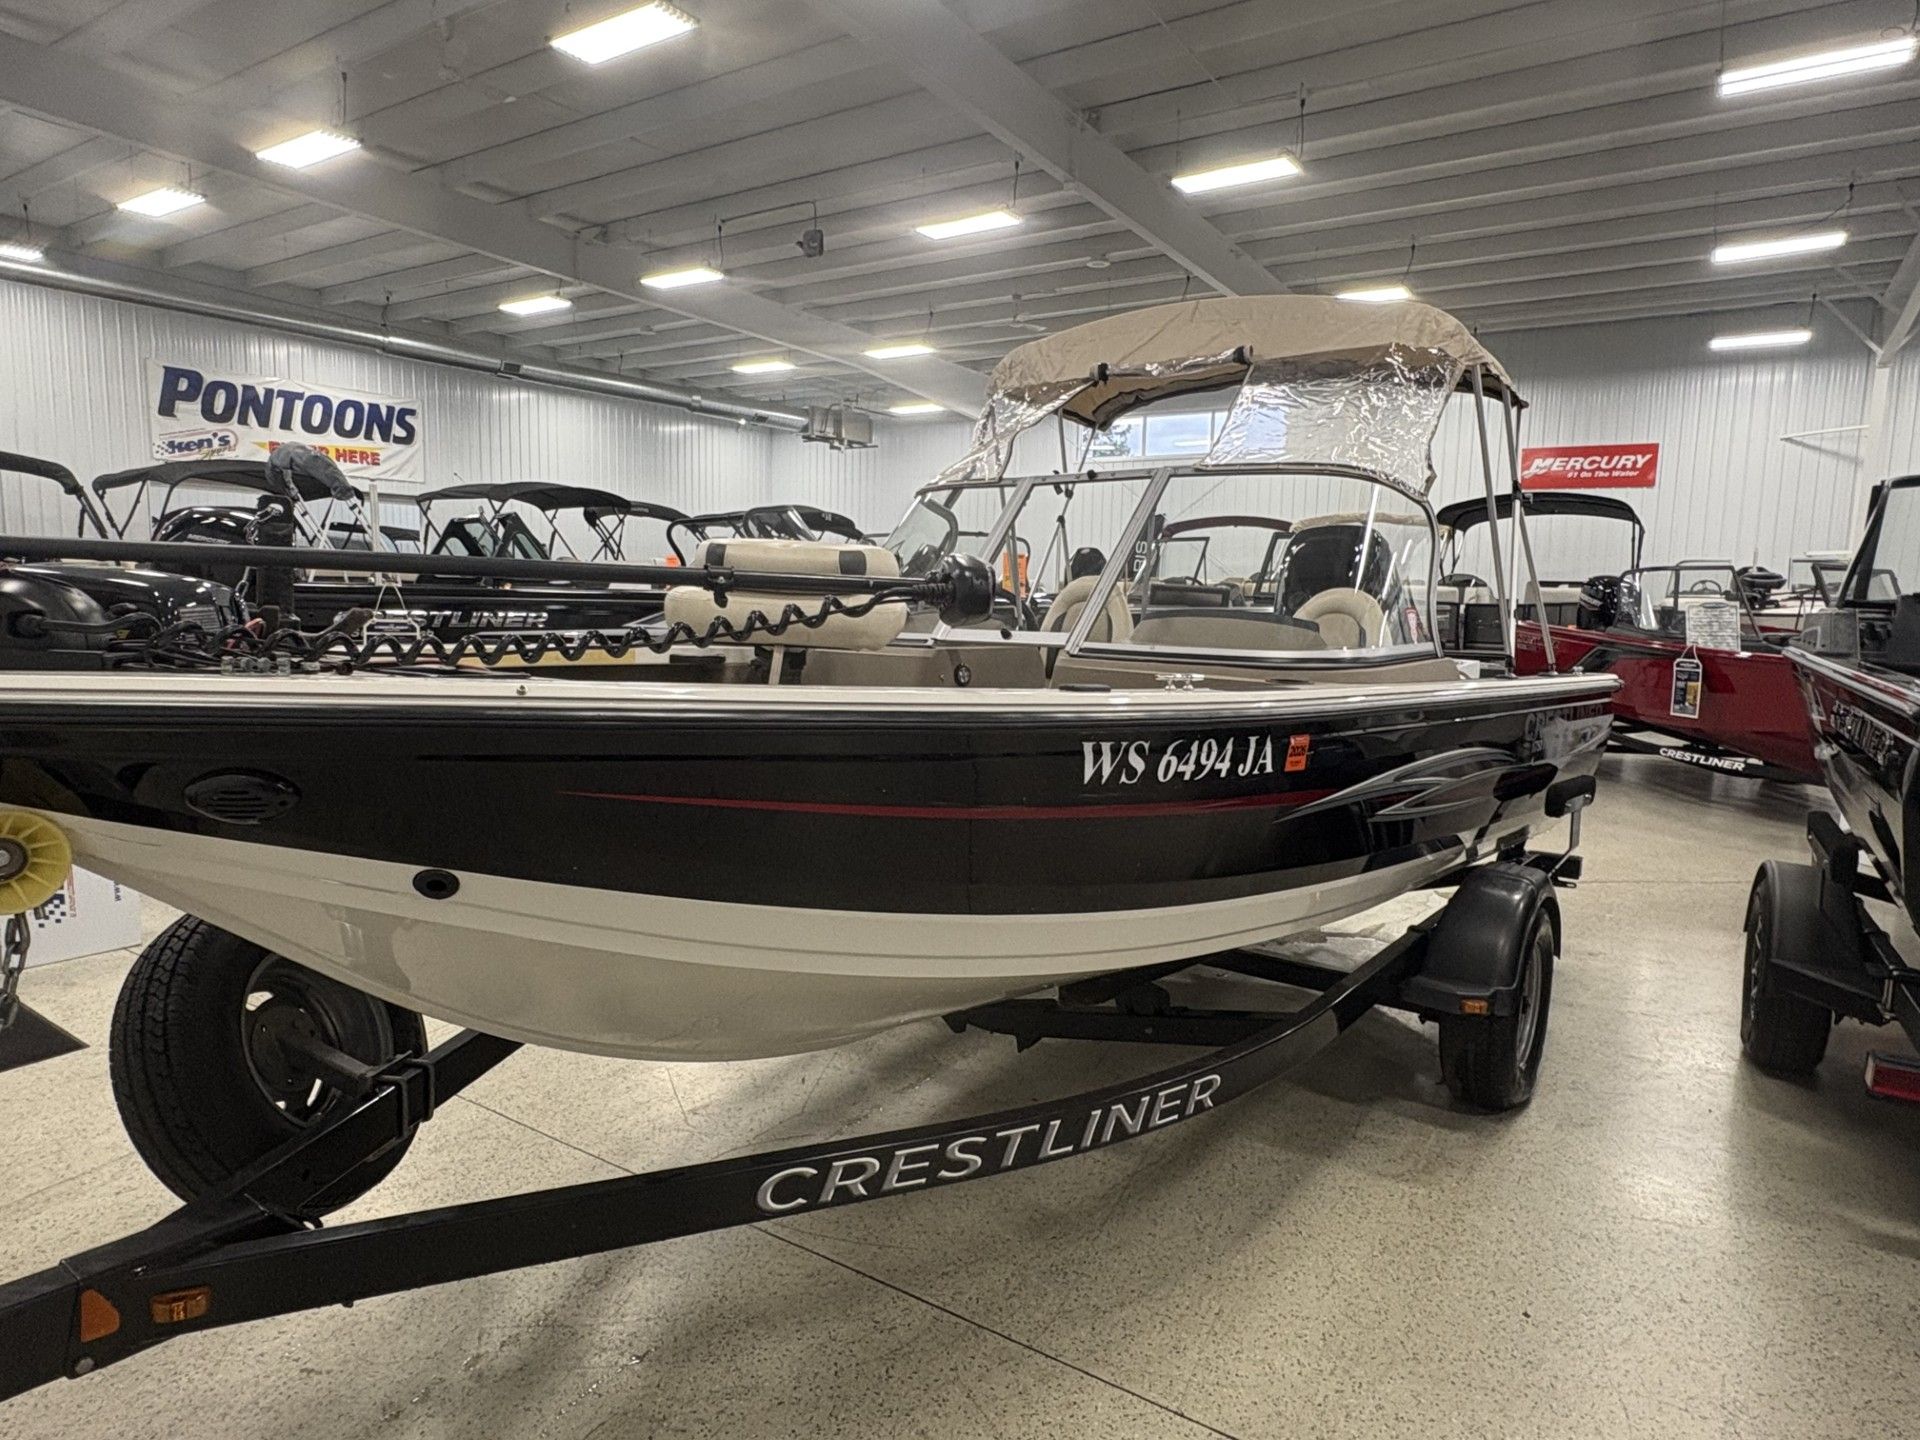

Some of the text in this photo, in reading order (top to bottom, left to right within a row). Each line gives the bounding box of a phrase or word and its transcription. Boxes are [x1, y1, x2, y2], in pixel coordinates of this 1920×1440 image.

[335, 447, 381, 466] HERE
[1529, 454, 1653, 473] MERCURY
[1082, 734, 1273, 785] WS 6494 JA
[1659, 747, 1745, 772] CRESTLINER
[757, 1073, 1221, 1212] CRESTLINER
